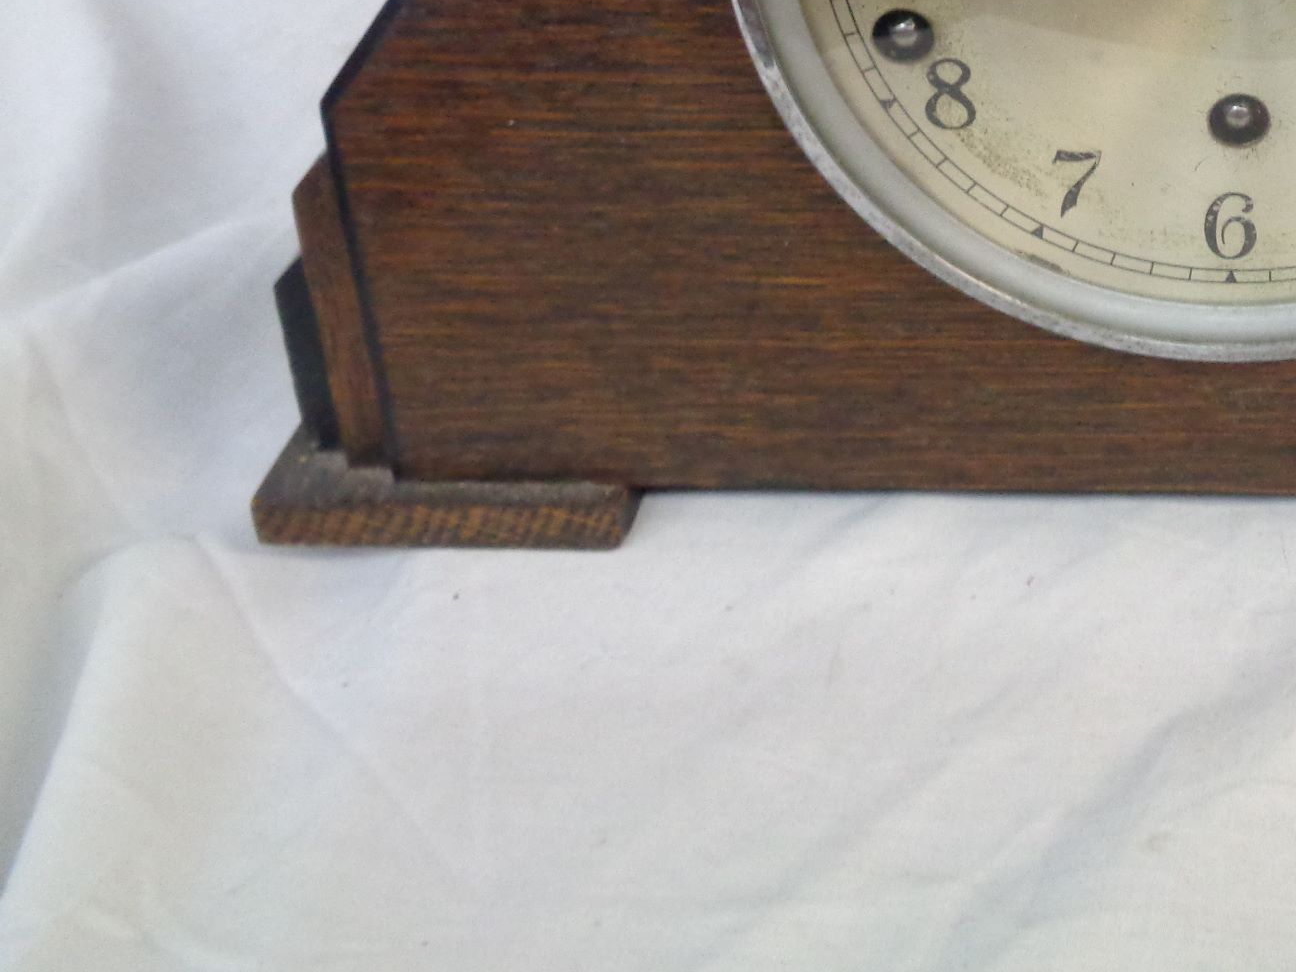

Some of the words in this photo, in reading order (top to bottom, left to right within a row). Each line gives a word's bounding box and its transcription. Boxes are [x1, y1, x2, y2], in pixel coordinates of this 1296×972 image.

[925, 58, 976, 130] 8
[1052, 150, 1102, 219] 7
[1204, 191, 1257, 260] 6
